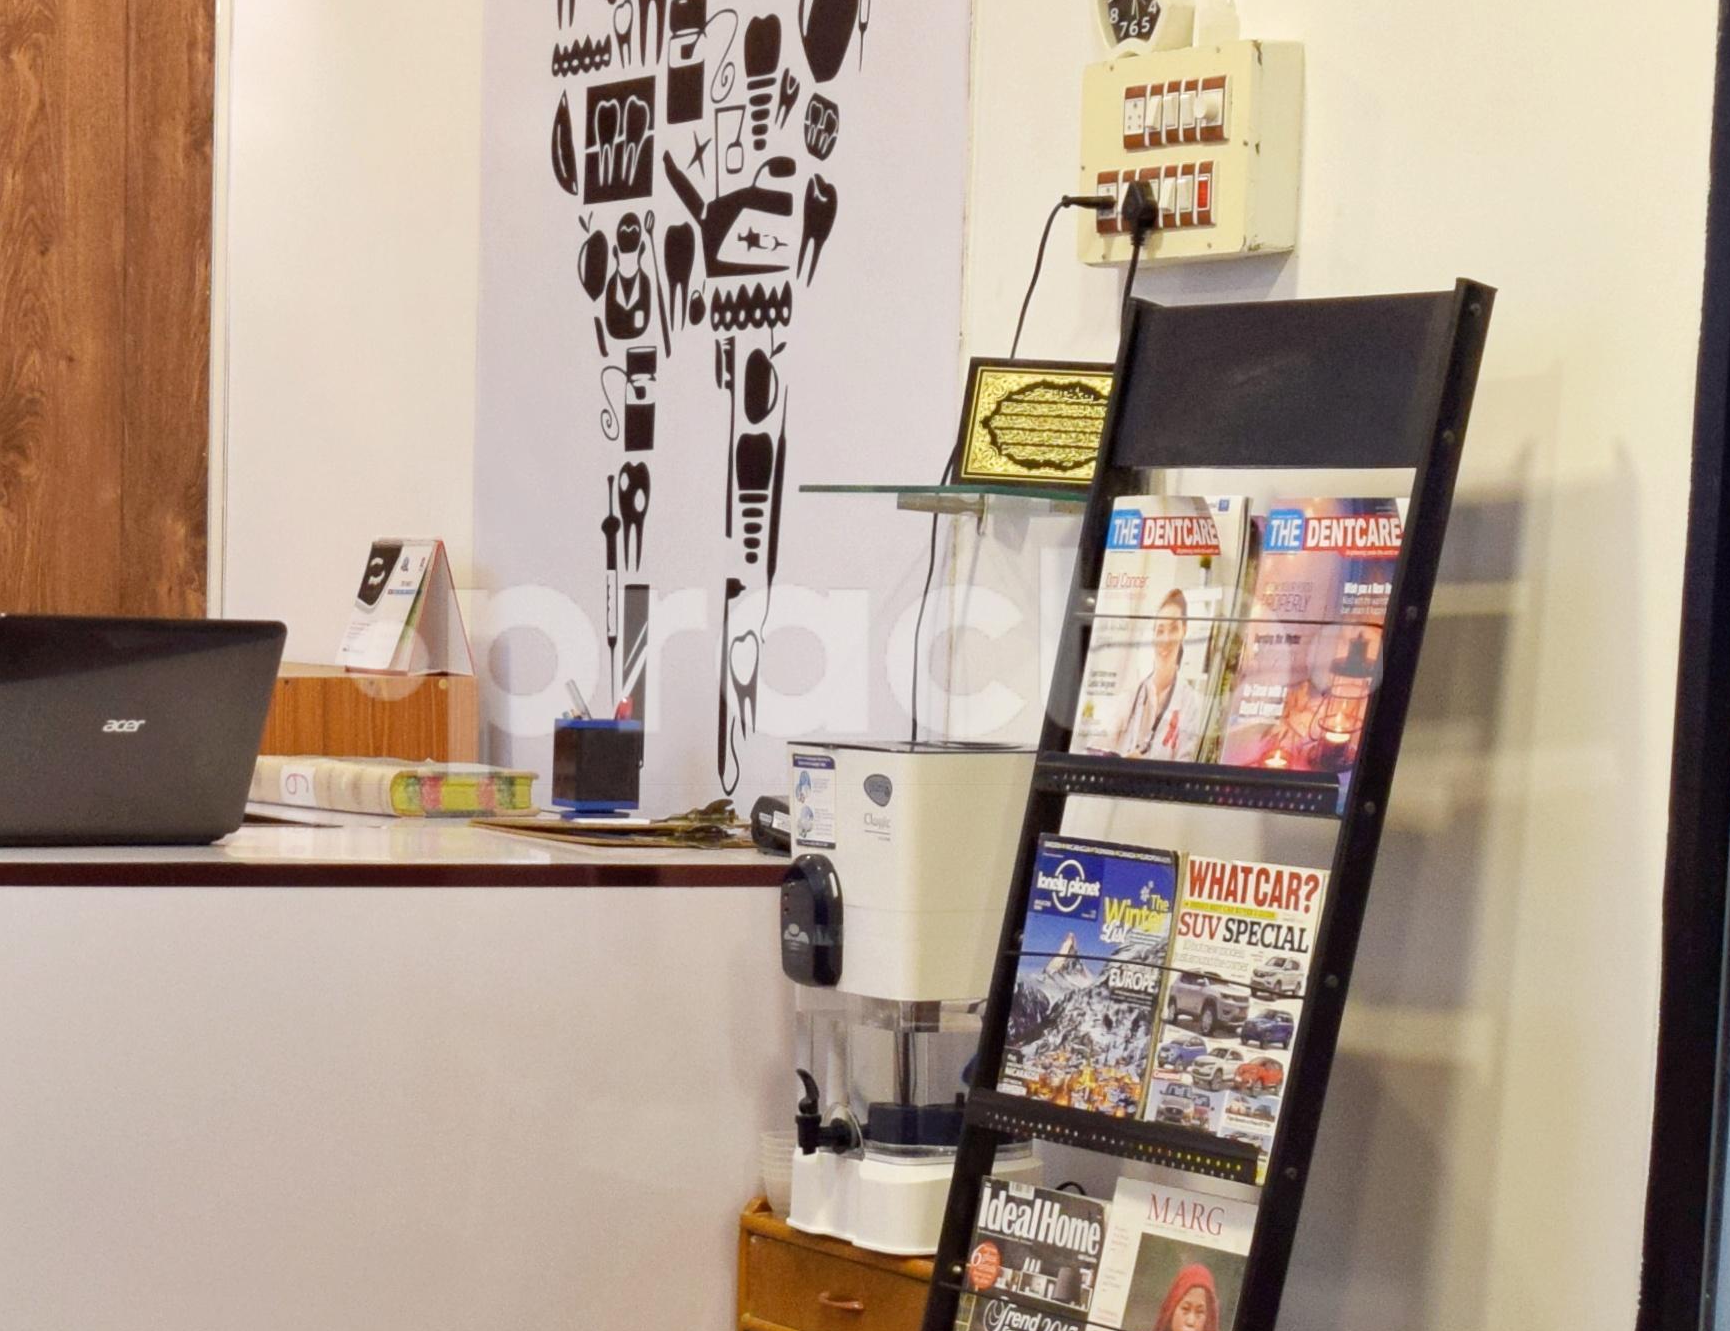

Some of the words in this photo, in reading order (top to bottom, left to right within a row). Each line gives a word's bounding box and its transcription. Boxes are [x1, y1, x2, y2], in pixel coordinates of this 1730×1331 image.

[1109, 7, 1120, 24] 8
[1119, 22, 1128, 39] 7
[1128, 19, 1139, 36] 6
[1141, 16, 1151, 33] 5
[1113, 518, 1141, 545] THE
[1143, 517, 1219, 546] DENTCARE
[1270, 518, 1302, 547] THE
[1306, 517, 1403, 547] DENTCARE
[103, 719, 146, 733] acer
[1037, 871, 1066, 897] lonely
[1068, 876, 1102, 898] planet
[1188, 859, 1253, 905] WHAT
[1254, 867, 1321, 915] CAR?
[1104, 896, 1165, 934] Winter
[1151, 894, 1170, 912] The
[1177, 911, 1222, 941] SUV
[1222, 917, 1310, 955] SPECIAL
[978, 1185, 1043, 1240] Ideal
[1038, 1199, 1101, 1256] Home
[1147, 1192, 1226, 1237] MARG
